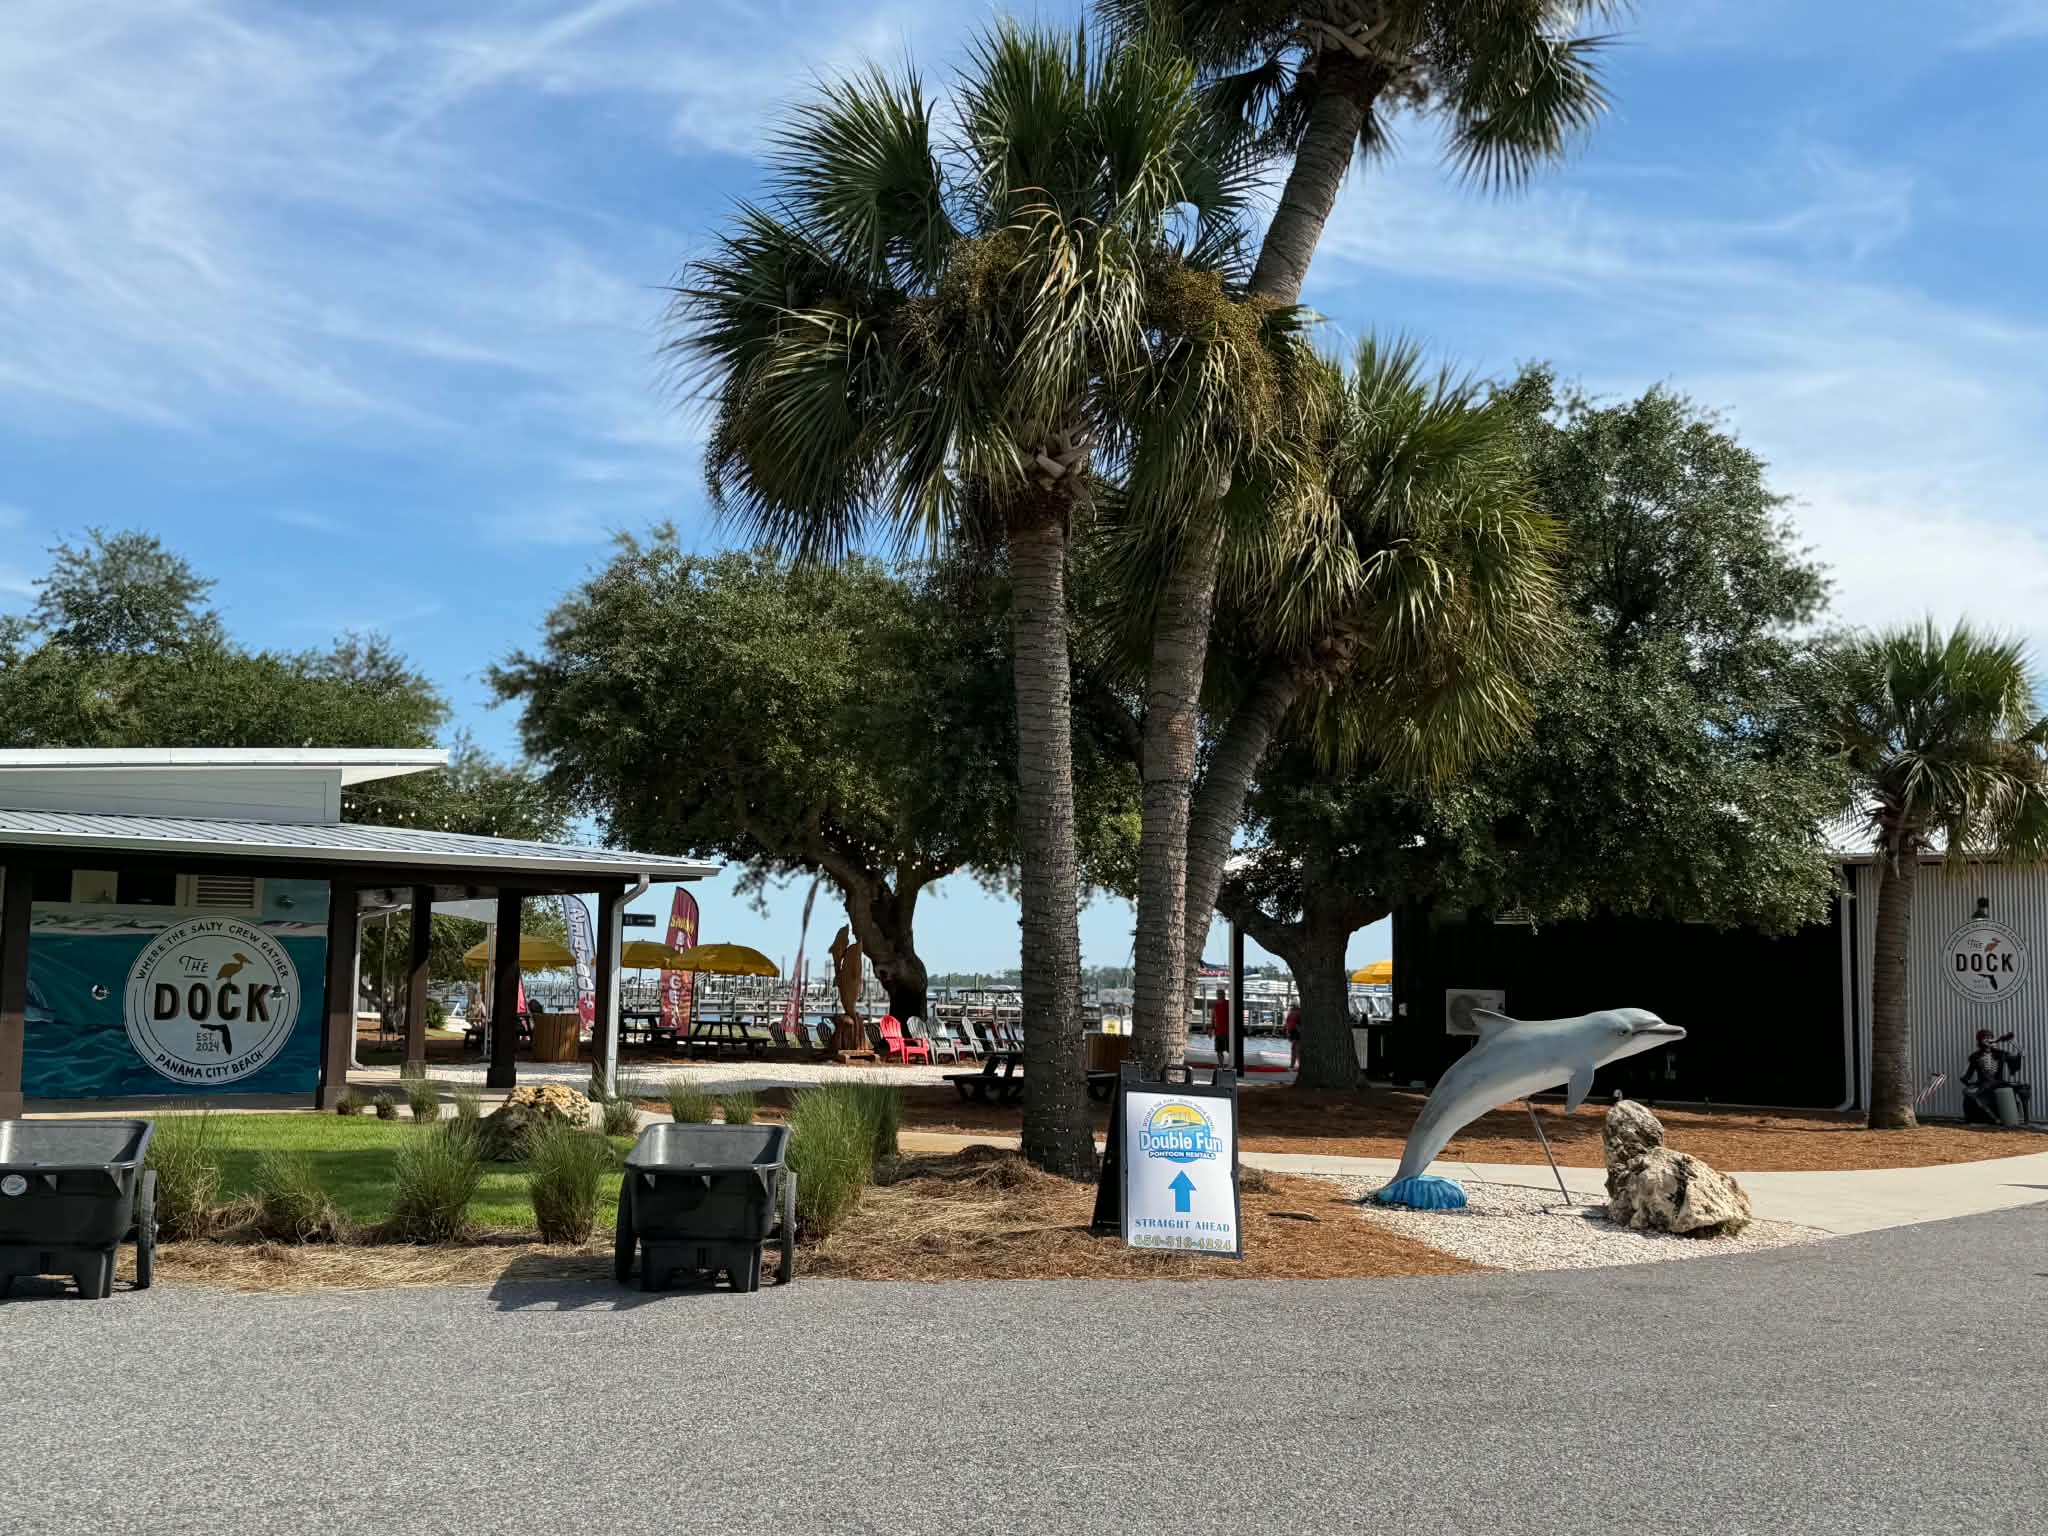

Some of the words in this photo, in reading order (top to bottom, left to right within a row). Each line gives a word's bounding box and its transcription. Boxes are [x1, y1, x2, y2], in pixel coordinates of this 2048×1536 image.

[136, 945, 165, 980] WHERE
[167, 928, 187, 945] THE
[191, 921, 224, 934] SALTY
[229, 924, 261, 943] CREW
[261, 940, 289, 978] GATHER
[1956, 953, 2014, 972] DOCK
[153, 982, 272, 1023] DOCK
[155, 1053, 203, 1078] PANAMA
[205, 1065, 230, 1079] CITY
[232, 1052, 264, 1074] BEACH
[1139, 1130, 1193, 1151] Double
[1194, 1131, 1223, 1152] Fun
[1135, 1218, 1192, 1230] STRAIGHT
[1195, 1221, 1230, 1233] AHEAD
